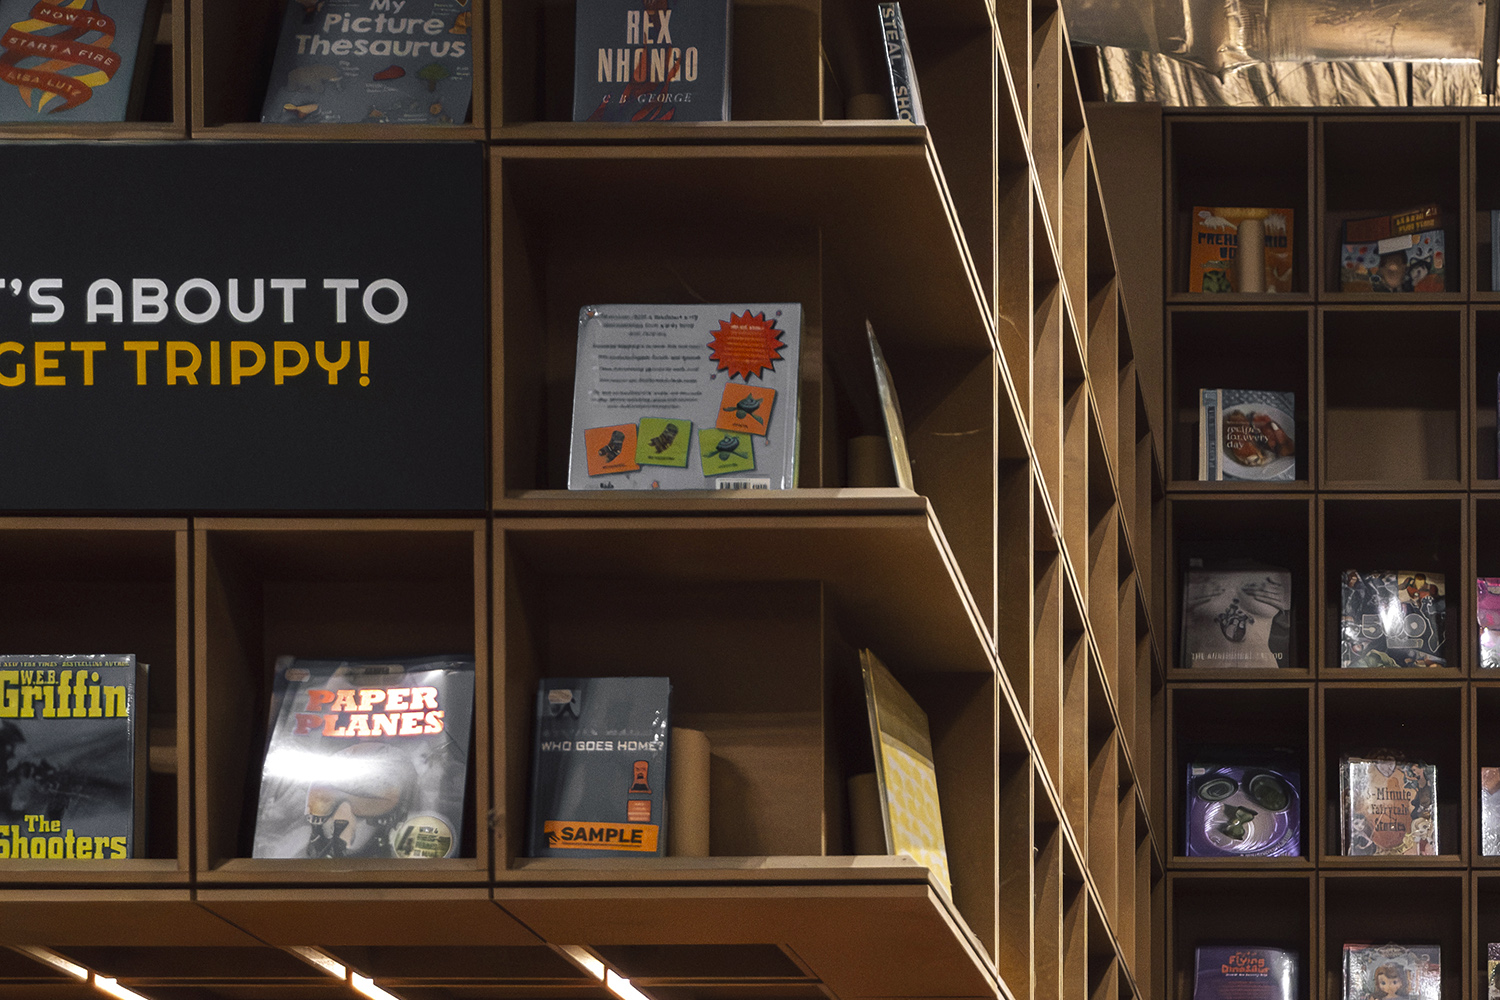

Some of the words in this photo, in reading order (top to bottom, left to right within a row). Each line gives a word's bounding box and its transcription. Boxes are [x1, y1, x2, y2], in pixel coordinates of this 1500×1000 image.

[323, 14, 445, 35] Picture
[626, 10, 672, 44] REX
[295, 34, 467, 58] Thesaurus
[597, 47, 699, 83] NHONGO
[86, 278, 307, 324] ABOUT
[323, 278, 409, 324] TO
[0, 341, 106, 387] GET
[124, 341, 372, 387] TRIPPY!
[19, 669, 60, 686] W.E.B.
[0, 669, 130, 719] Griffin
[306, 686, 439, 712] PAPER
[294, 710, 445, 738] PLANES
[541, 741, 573, 752] WHO
[576, 741, 613, 752] GOES
[617, 740, 665, 752] HOME?
[24, 815, 61, 834] The
[560, 826, 644, 845] SAMPLE
[0, 825, 127, 859] Shooters
[1221, 965, 1270, 974] Dinosaur
[1229, 955, 1265, 967] Flying
